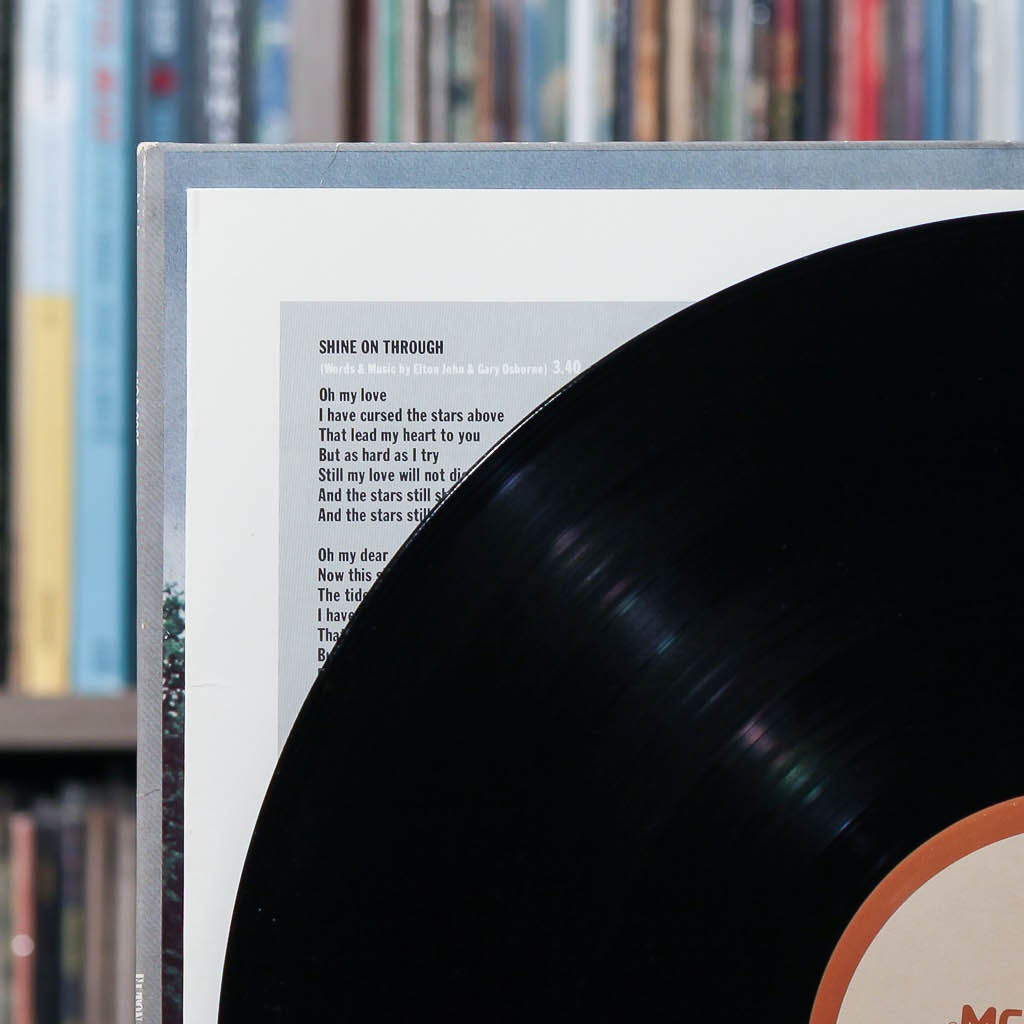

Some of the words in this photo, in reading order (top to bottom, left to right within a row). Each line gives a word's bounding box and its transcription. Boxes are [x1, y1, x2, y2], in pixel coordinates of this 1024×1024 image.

[319, 340, 357, 354] SHINE
[361, 340, 378, 354] ON
[383, 340, 443, 354] THROUGH
[320, 362, 355, 375] (Words
[357, 363, 365, 375] &
[368, 363, 395, 375] Music
[398, 363, 411, 376] by
[413, 363, 439, 375] Elton
[442, 363, 465, 376] John
[467, 364, 474, 375] &
[477, 364, 499, 376] Gary
[502, 364, 548, 376] Osborne)
[552, 359, 581, 374] 3.40
[320, 388, 334, 401] Oh
[340, 392, 357, 404] my
[361, 388, 386, 401] love
[319, 408, 323, 422] I
[328, 408, 356, 422] have
[360, 408, 402, 422] cursed
[407, 408, 427, 422] the
[431, 409, 463, 422] stars
[468, 408, 504, 422] above
[319, 428, 347, 441] That
[351, 428, 376, 441] lead
[381, 432, 398, 444] my
[403, 428, 436, 442] heart
[440, 428, 453, 442] to
[458, 432, 480, 445] you
[319, 448, 340, 462] But
[344, 451, 358, 462] as
[362, 448, 390, 461] hard
[394, 451, 408, 462] as
[413, 448, 416, 462] I
[421, 449, 439, 464] try
[319, 468, 343, 482] Still
[348, 472, 365, 484] my
[369, 468, 395, 481] love
[399, 468, 419, 482] will
[425, 468, 445, 482] not
[318, 488, 341, 502] And
[346, 488, 366, 502] the
[371, 489, 403, 502] stars
[407, 488, 430, 502] still
[318, 508, 341, 522] And
[346, 508, 366, 522] the
[371, 508, 403, 521] stars
[318, 548, 334, 561] Oh
[339, 552, 356, 564] my
[361, 548, 388, 561] dear
[318, 568, 344, 582] Now
[348, 568, 372, 582] this
[317, 588, 340, 602] The
[318, 608, 321, 622] I
